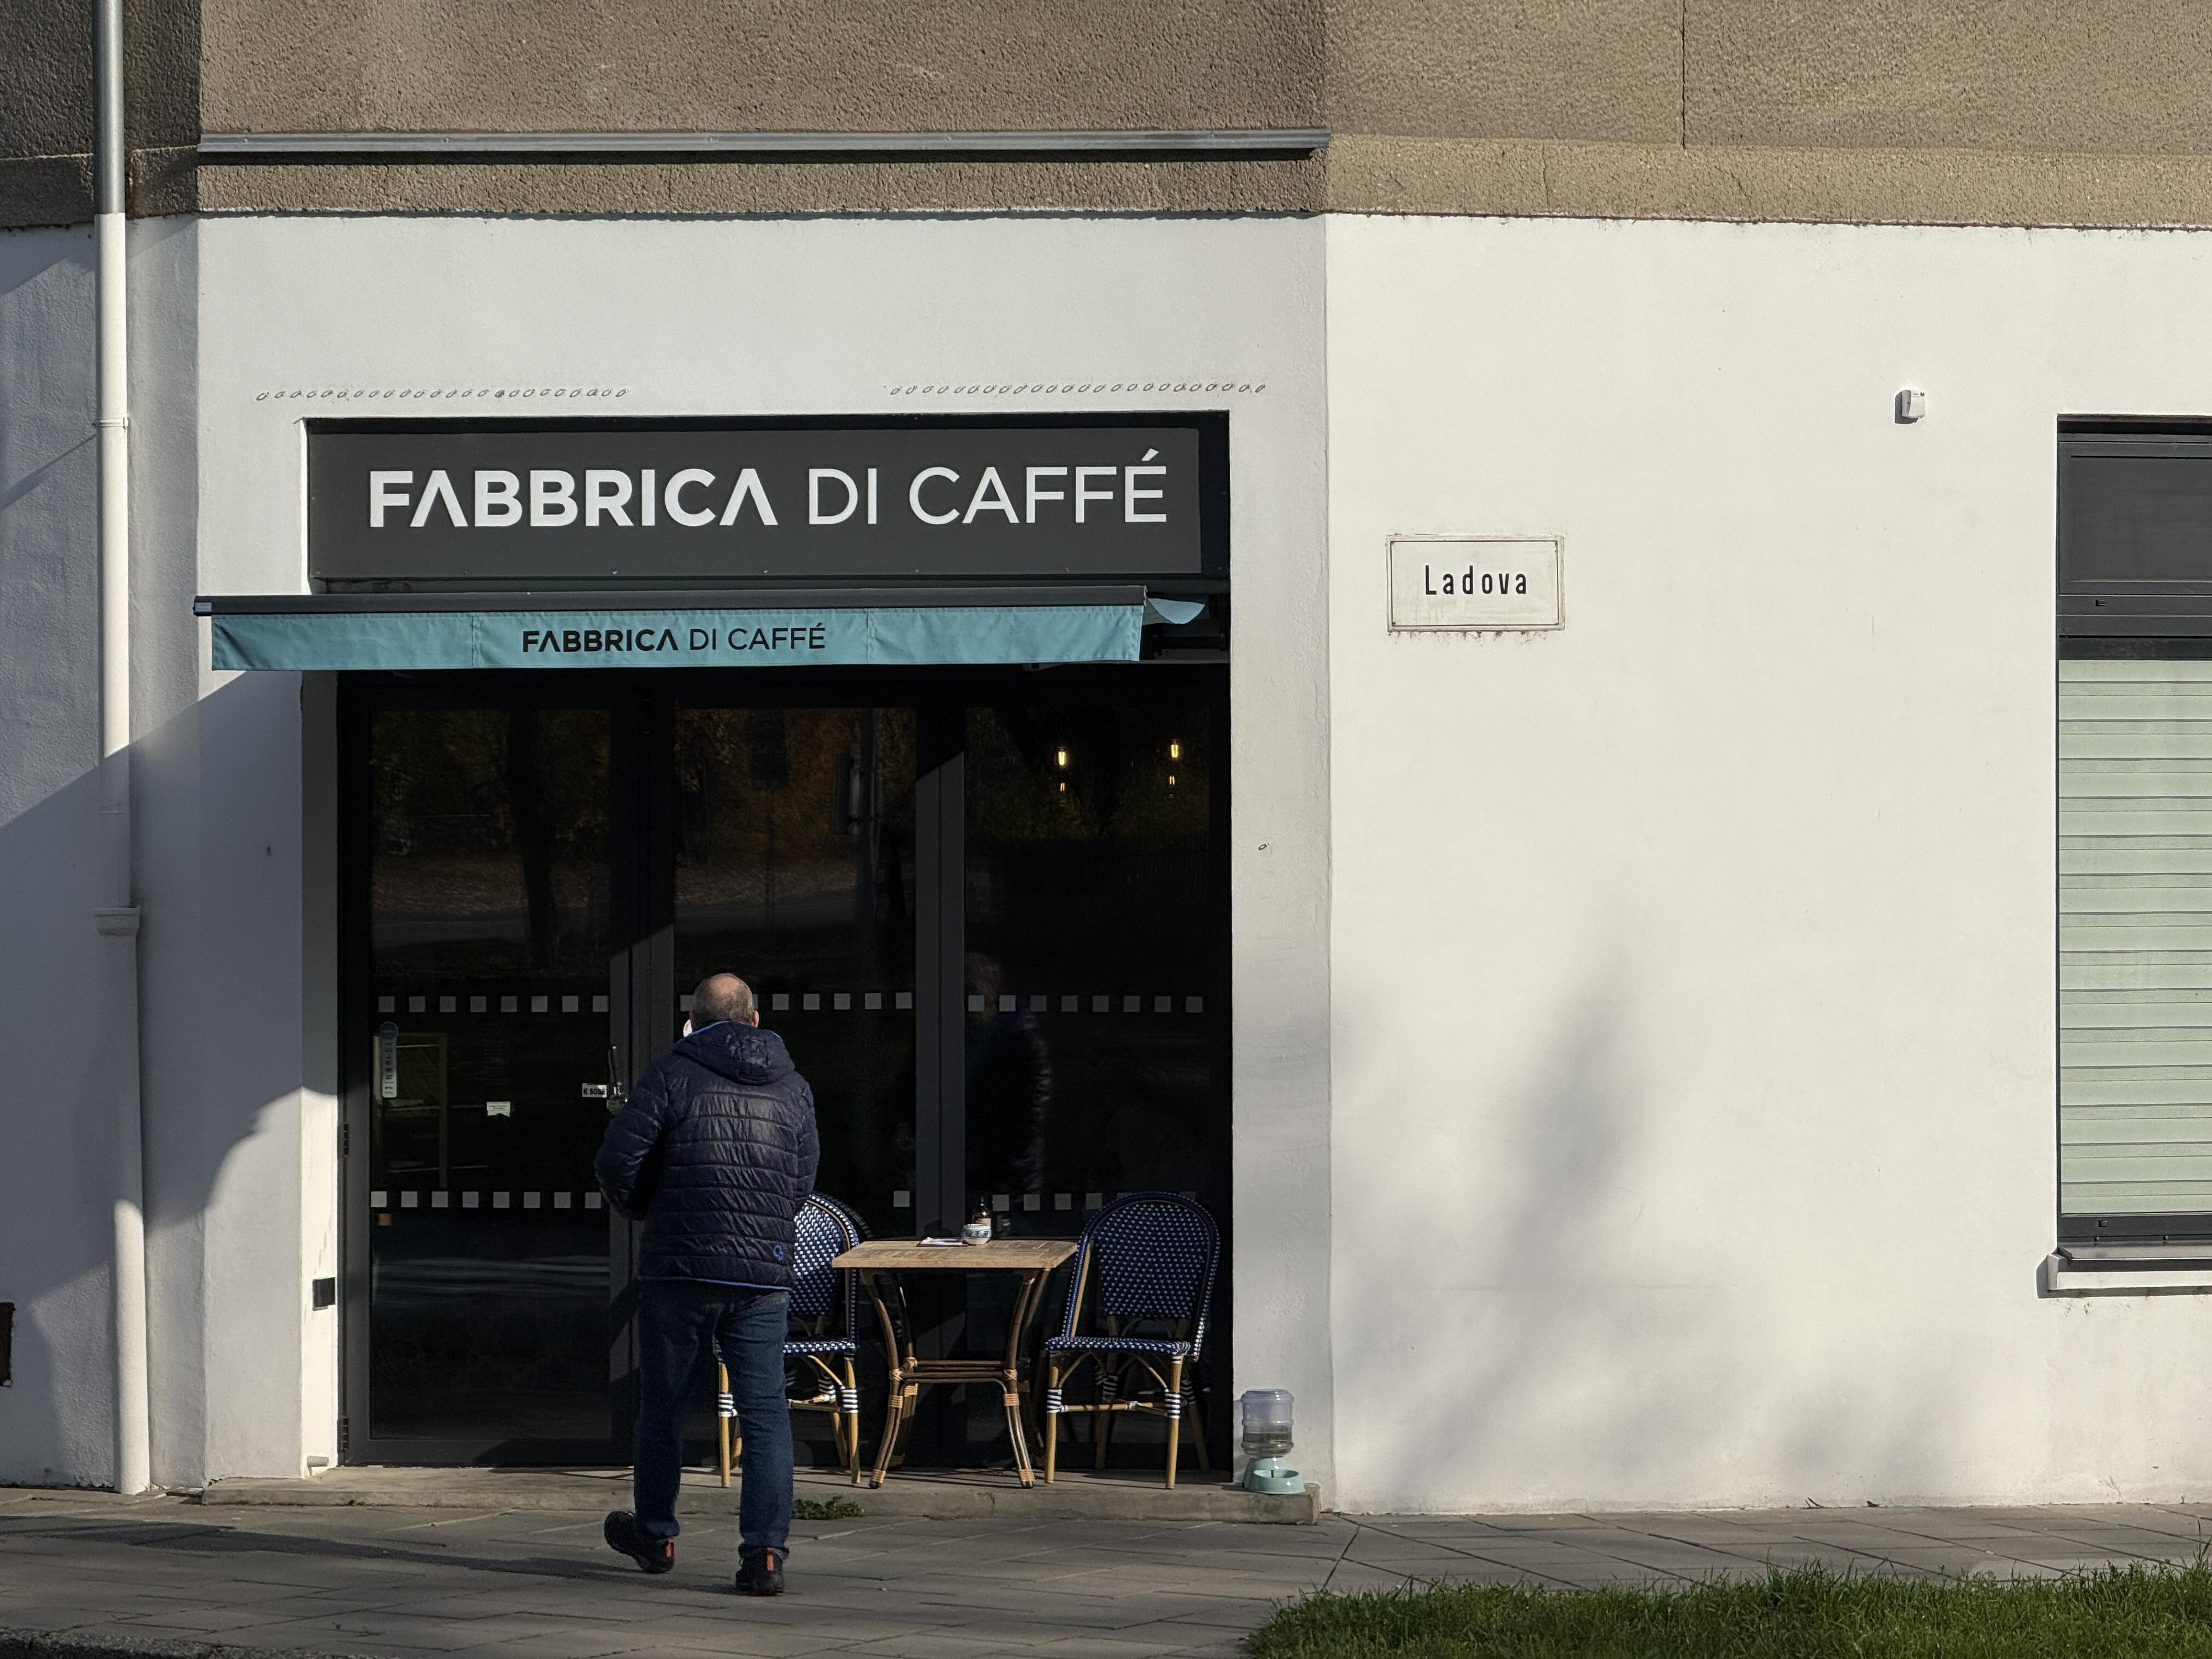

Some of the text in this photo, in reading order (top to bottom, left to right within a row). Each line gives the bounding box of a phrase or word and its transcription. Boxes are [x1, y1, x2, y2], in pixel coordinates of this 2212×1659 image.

[370, 448, 1167, 528] FABBRICA DI CAFFÉ
[1425, 565, 1527, 595] Ladova
[523, 622, 826, 653] FABBRICA DI CAFFÉ
